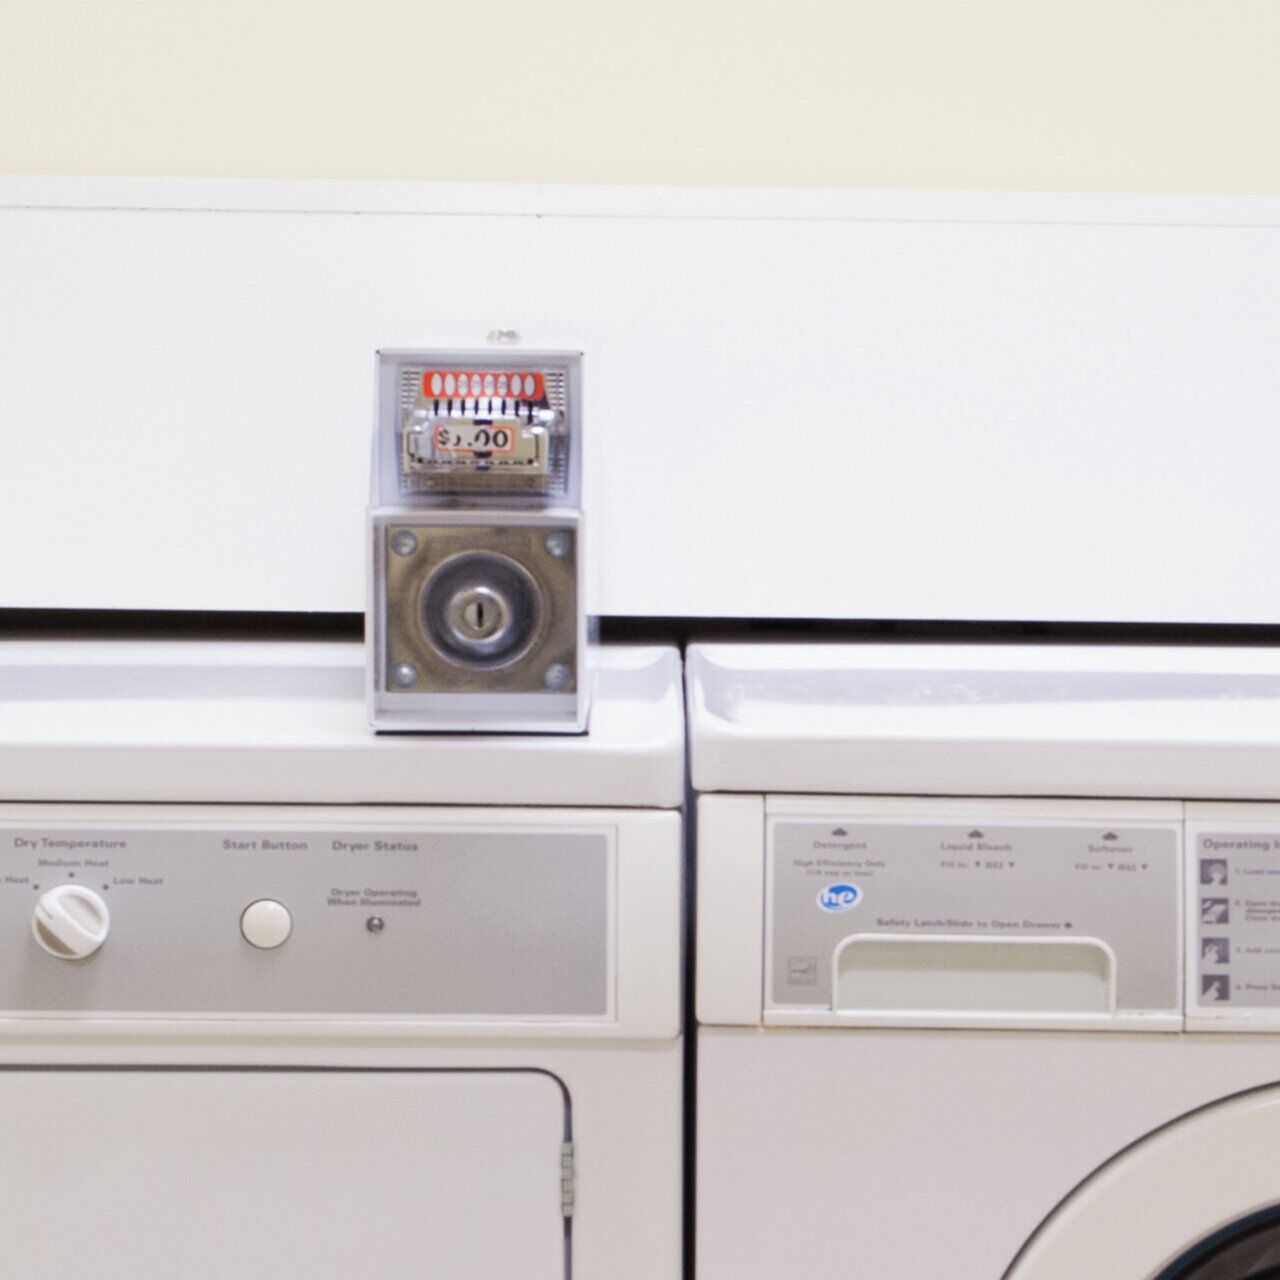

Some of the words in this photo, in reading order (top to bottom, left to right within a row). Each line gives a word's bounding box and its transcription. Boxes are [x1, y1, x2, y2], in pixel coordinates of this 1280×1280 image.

[14, 838, 38, 850] Dry
[42, 838, 127, 850] Temperature
[223, 840, 257, 850] Start
[262, 840, 308, 850] Button
[332, 841, 369, 852] Dryer
[374, 841, 419, 851] Status
[813, 841, 867, 851] Detergent
[940, 842, 973, 851] Liquid
[977, 842, 1013, 851] Bleach
[1088, 844, 1133, 853] Softener
[1203, 839, 1270, 851] Operating
[38, 859, 81, 867] Medium
[84, 859, 109, 867] Heat
[5, 876, 30, 884] Heat
[113, 877, 135, 885] Low
[138, 877, 164, 885] Heat
[331, 889, 361, 898] Dryer
[364, 889, 418, 898] Operating
[821, 884, 858, 910] he
[327, 898, 357, 906] When
[360, 898, 421, 906] Illuminated
[878, 918, 911, 928] Safety
[914, 918, 973, 928] Latch/Slide
[977, 919, 988, 928] to
[992, 920, 1020, 930] Open
